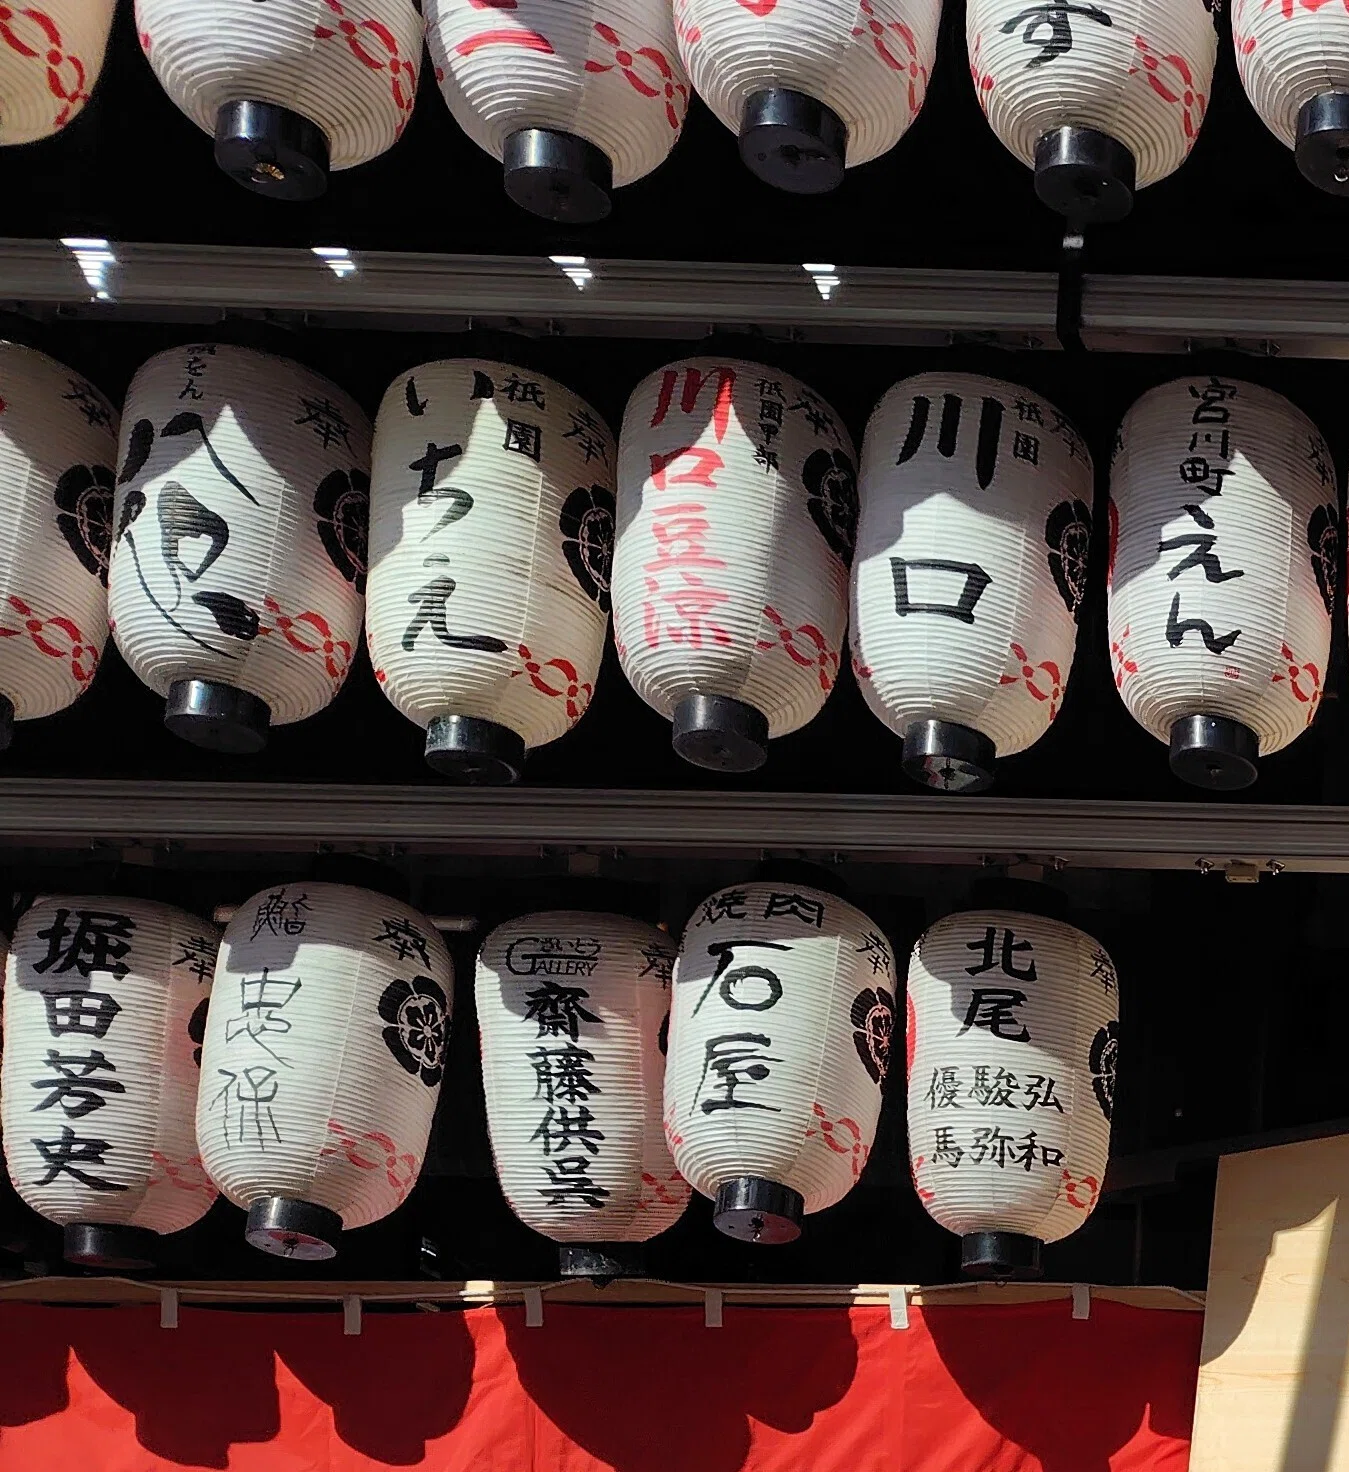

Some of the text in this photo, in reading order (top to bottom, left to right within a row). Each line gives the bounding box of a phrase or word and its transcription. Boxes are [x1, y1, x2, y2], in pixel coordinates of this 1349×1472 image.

[891, 394, 1004, 625] 川口
[1158, 376, 1245, 656] 宮川町 えん
[504, 936, 600, 977] GALLERY
[696, 890, 827, 929] 焼肉
[955, 926, 1039, 1044] 北尾
